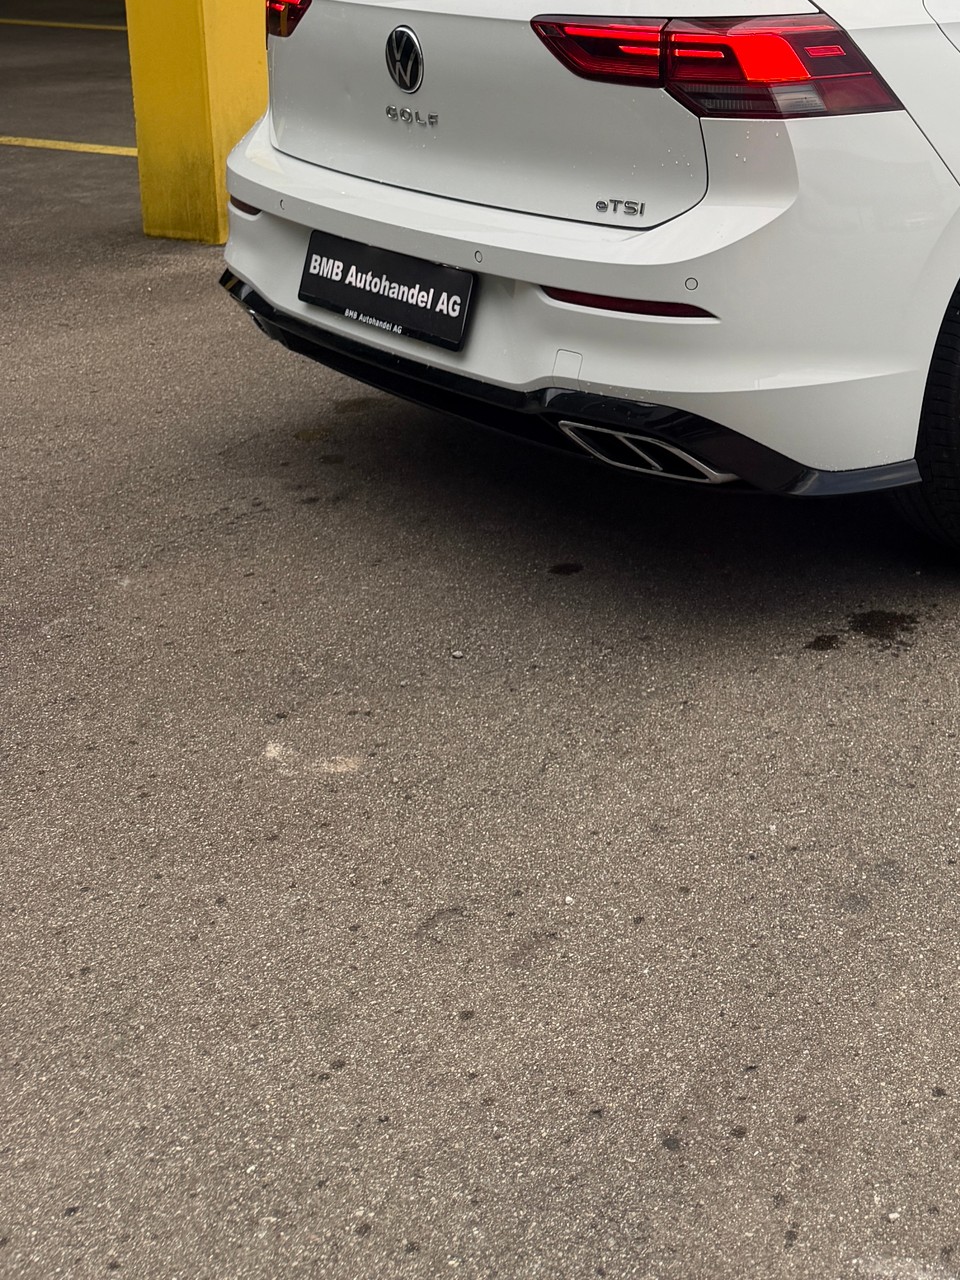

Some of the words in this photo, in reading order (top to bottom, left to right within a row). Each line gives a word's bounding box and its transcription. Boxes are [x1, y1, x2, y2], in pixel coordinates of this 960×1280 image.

[386, 105, 439, 127] GOLF
[595, 199, 646, 217] eTSI
[309, 253, 344, 282] BMB
[345, 265, 434, 310] Autohandel
[435, 291, 462, 318] AG
[344, 308, 358, 321] BMB
[358, 313, 393, 331] Autohandel
[392, 324, 403, 335] AG
